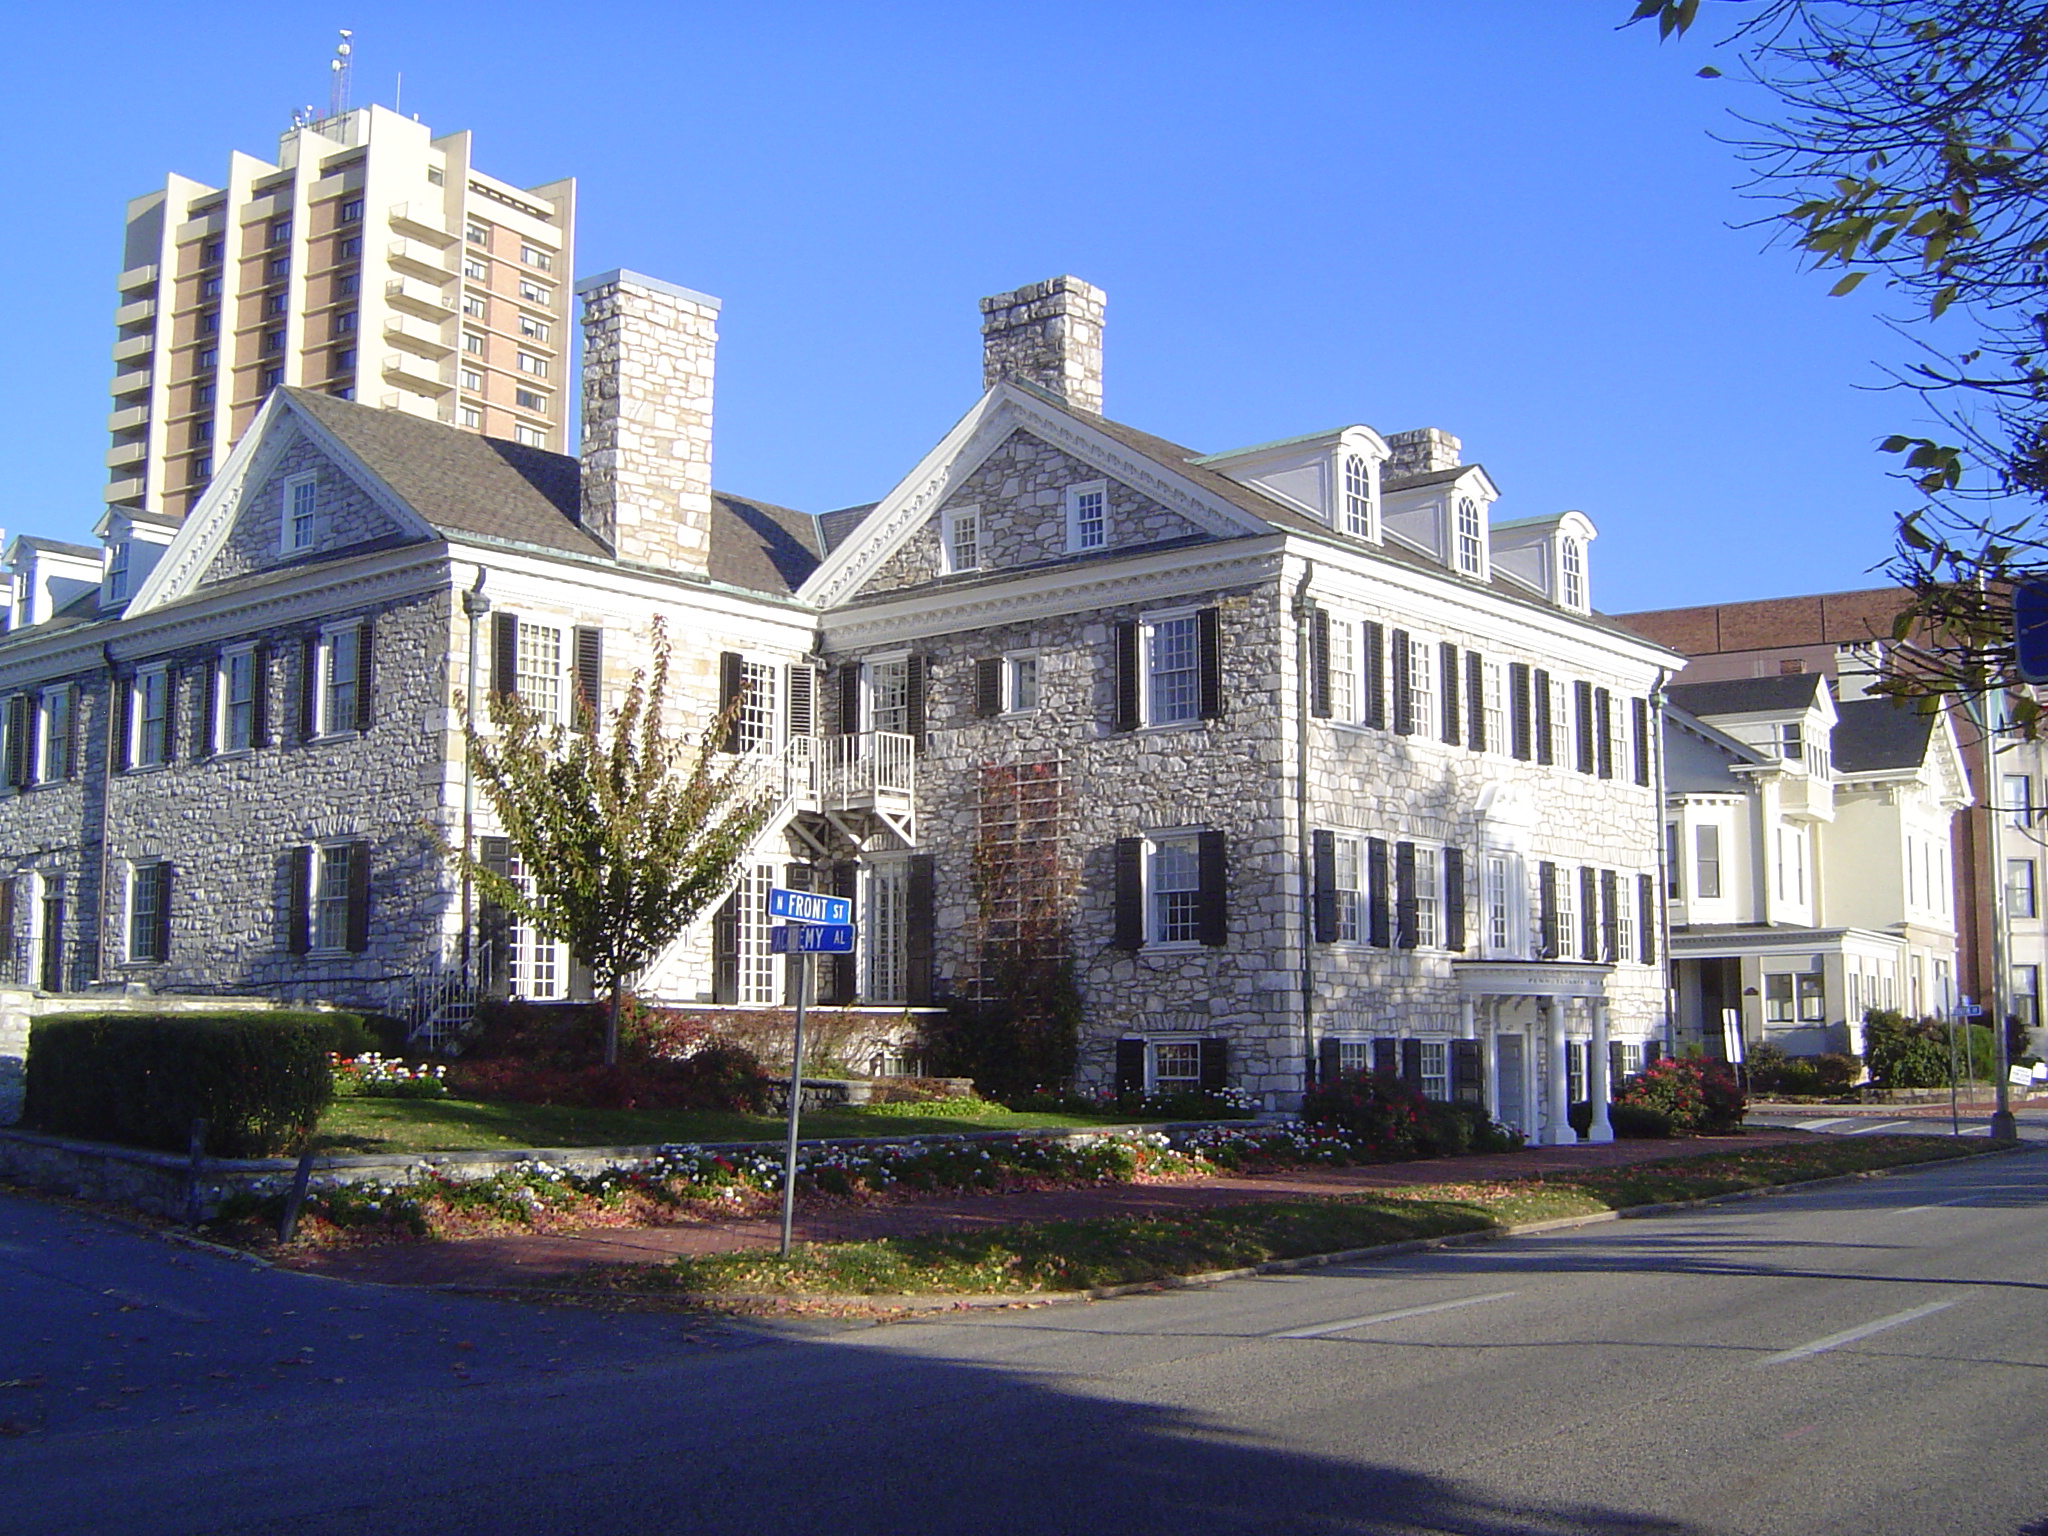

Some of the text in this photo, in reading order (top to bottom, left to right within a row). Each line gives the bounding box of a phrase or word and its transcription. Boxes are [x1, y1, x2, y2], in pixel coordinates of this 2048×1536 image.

[776, 894, 844, 920] N FRONT ST
[833, 930, 846, 945] AL
[1528, 977, 1584, 985] PENNYLVANIA
